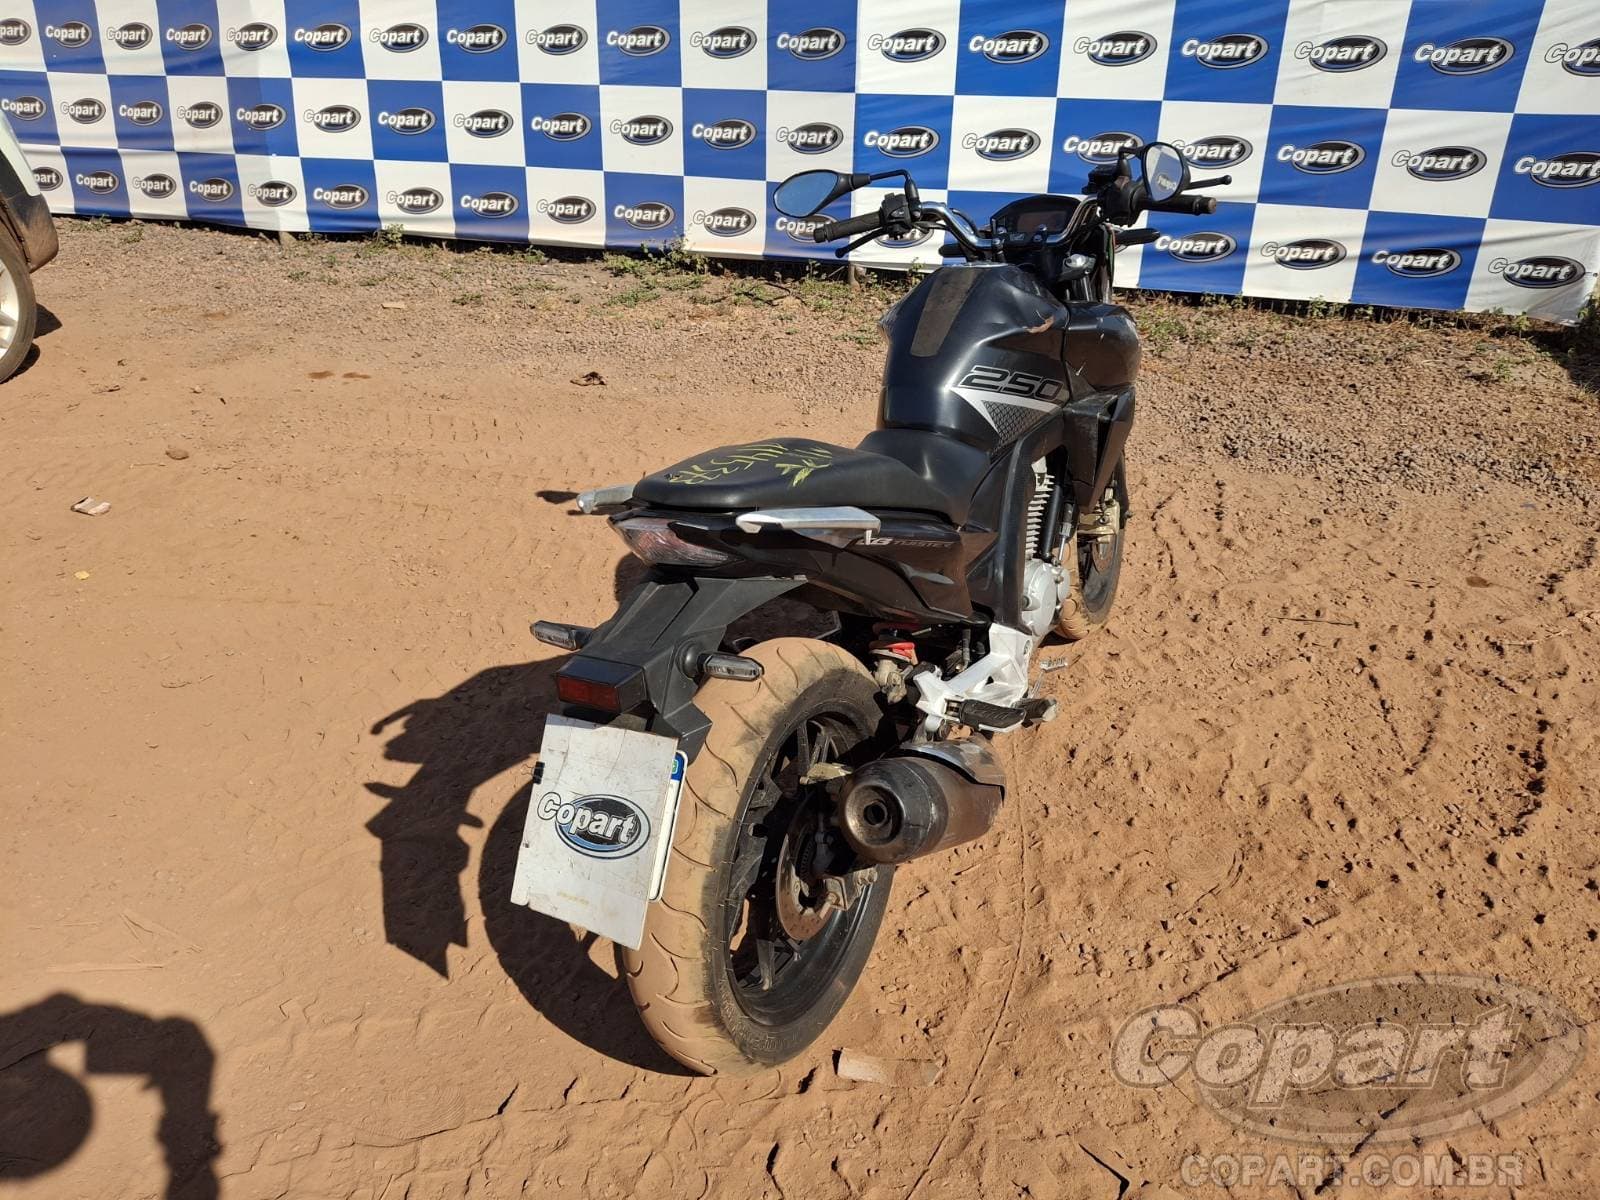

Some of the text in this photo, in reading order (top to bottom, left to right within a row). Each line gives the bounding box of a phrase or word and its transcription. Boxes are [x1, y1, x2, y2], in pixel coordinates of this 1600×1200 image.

[0, 24, 24, 39] part
[46, 25, 86, 43] Copart
[107, 25, 146, 43] Copart
[166, 27, 206, 45] Copart
[227, 26, 270, 46] Copart
[294, 28, 344, 46] Copart
[370, 28, 421, 47] Copart
[446, 28, 500, 48] Copart
[526, 28, 580, 50] Copart
[607, 30, 662, 50] Copart
[690, 32, 748, 52] Copart
[777, 32, 837, 52] Copart
[868, 33, 934, 55] Copart
[969, 34, 1039, 56] Copart
[1074, 37, 1148, 58] Copart
[1182, 39, 1258, 59] Copart
[1295, 41, 1378, 62] Copart
[1415, 42, 1504, 64] Copart
[1544, 43, 1600, 66] Cop
[1, 98, 40, 116] Copart
[61, 101, 100, 119] Copart
[119, 103, 158, 120] Copart
[177, 105, 216, 122] Copart
[237, 107, 280, 125] Copart
[304, 109, 354, 126] Copart
[378, 111, 428, 129] Copart
[454, 113, 506, 132] Copart
[531, 116, 585, 137] Copart
[610, 118, 665, 139] Copart
[692, 123, 748, 143] Copart
[776, 126, 834, 148] Copart
[864, 130, 929, 151] Copart
[962, 133, 1029, 154] Copart
[1277, 145, 1356, 166] Copart
[1392, 150, 1477, 173] Copart
[1515, 156, 1600, 178] Copart
[34, 170, 58, 185] part
[76, 174, 113, 190] Copart
[133, 176, 171, 193] Copart
[189, 180, 228, 196] Copart
[248, 183, 290, 201] Copart
[313, 187, 362, 205] Copart
[387, 190, 437, 208] Copart
[461, 194, 511, 212] Copart
[536, 199, 588, 220] Copart
[614, 204, 668, 224] Copart
[693, 210, 748, 230] Copart
[1156, 235, 1227, 255] Copart
[1261, 241, 1336, 262] Copart
[1372, 250, 1451, 270] Copart
[1489, 257, 1574, 281] Copart
[957, 365, 1064, 402] 250
[537, 792, 637, 843] Copart
